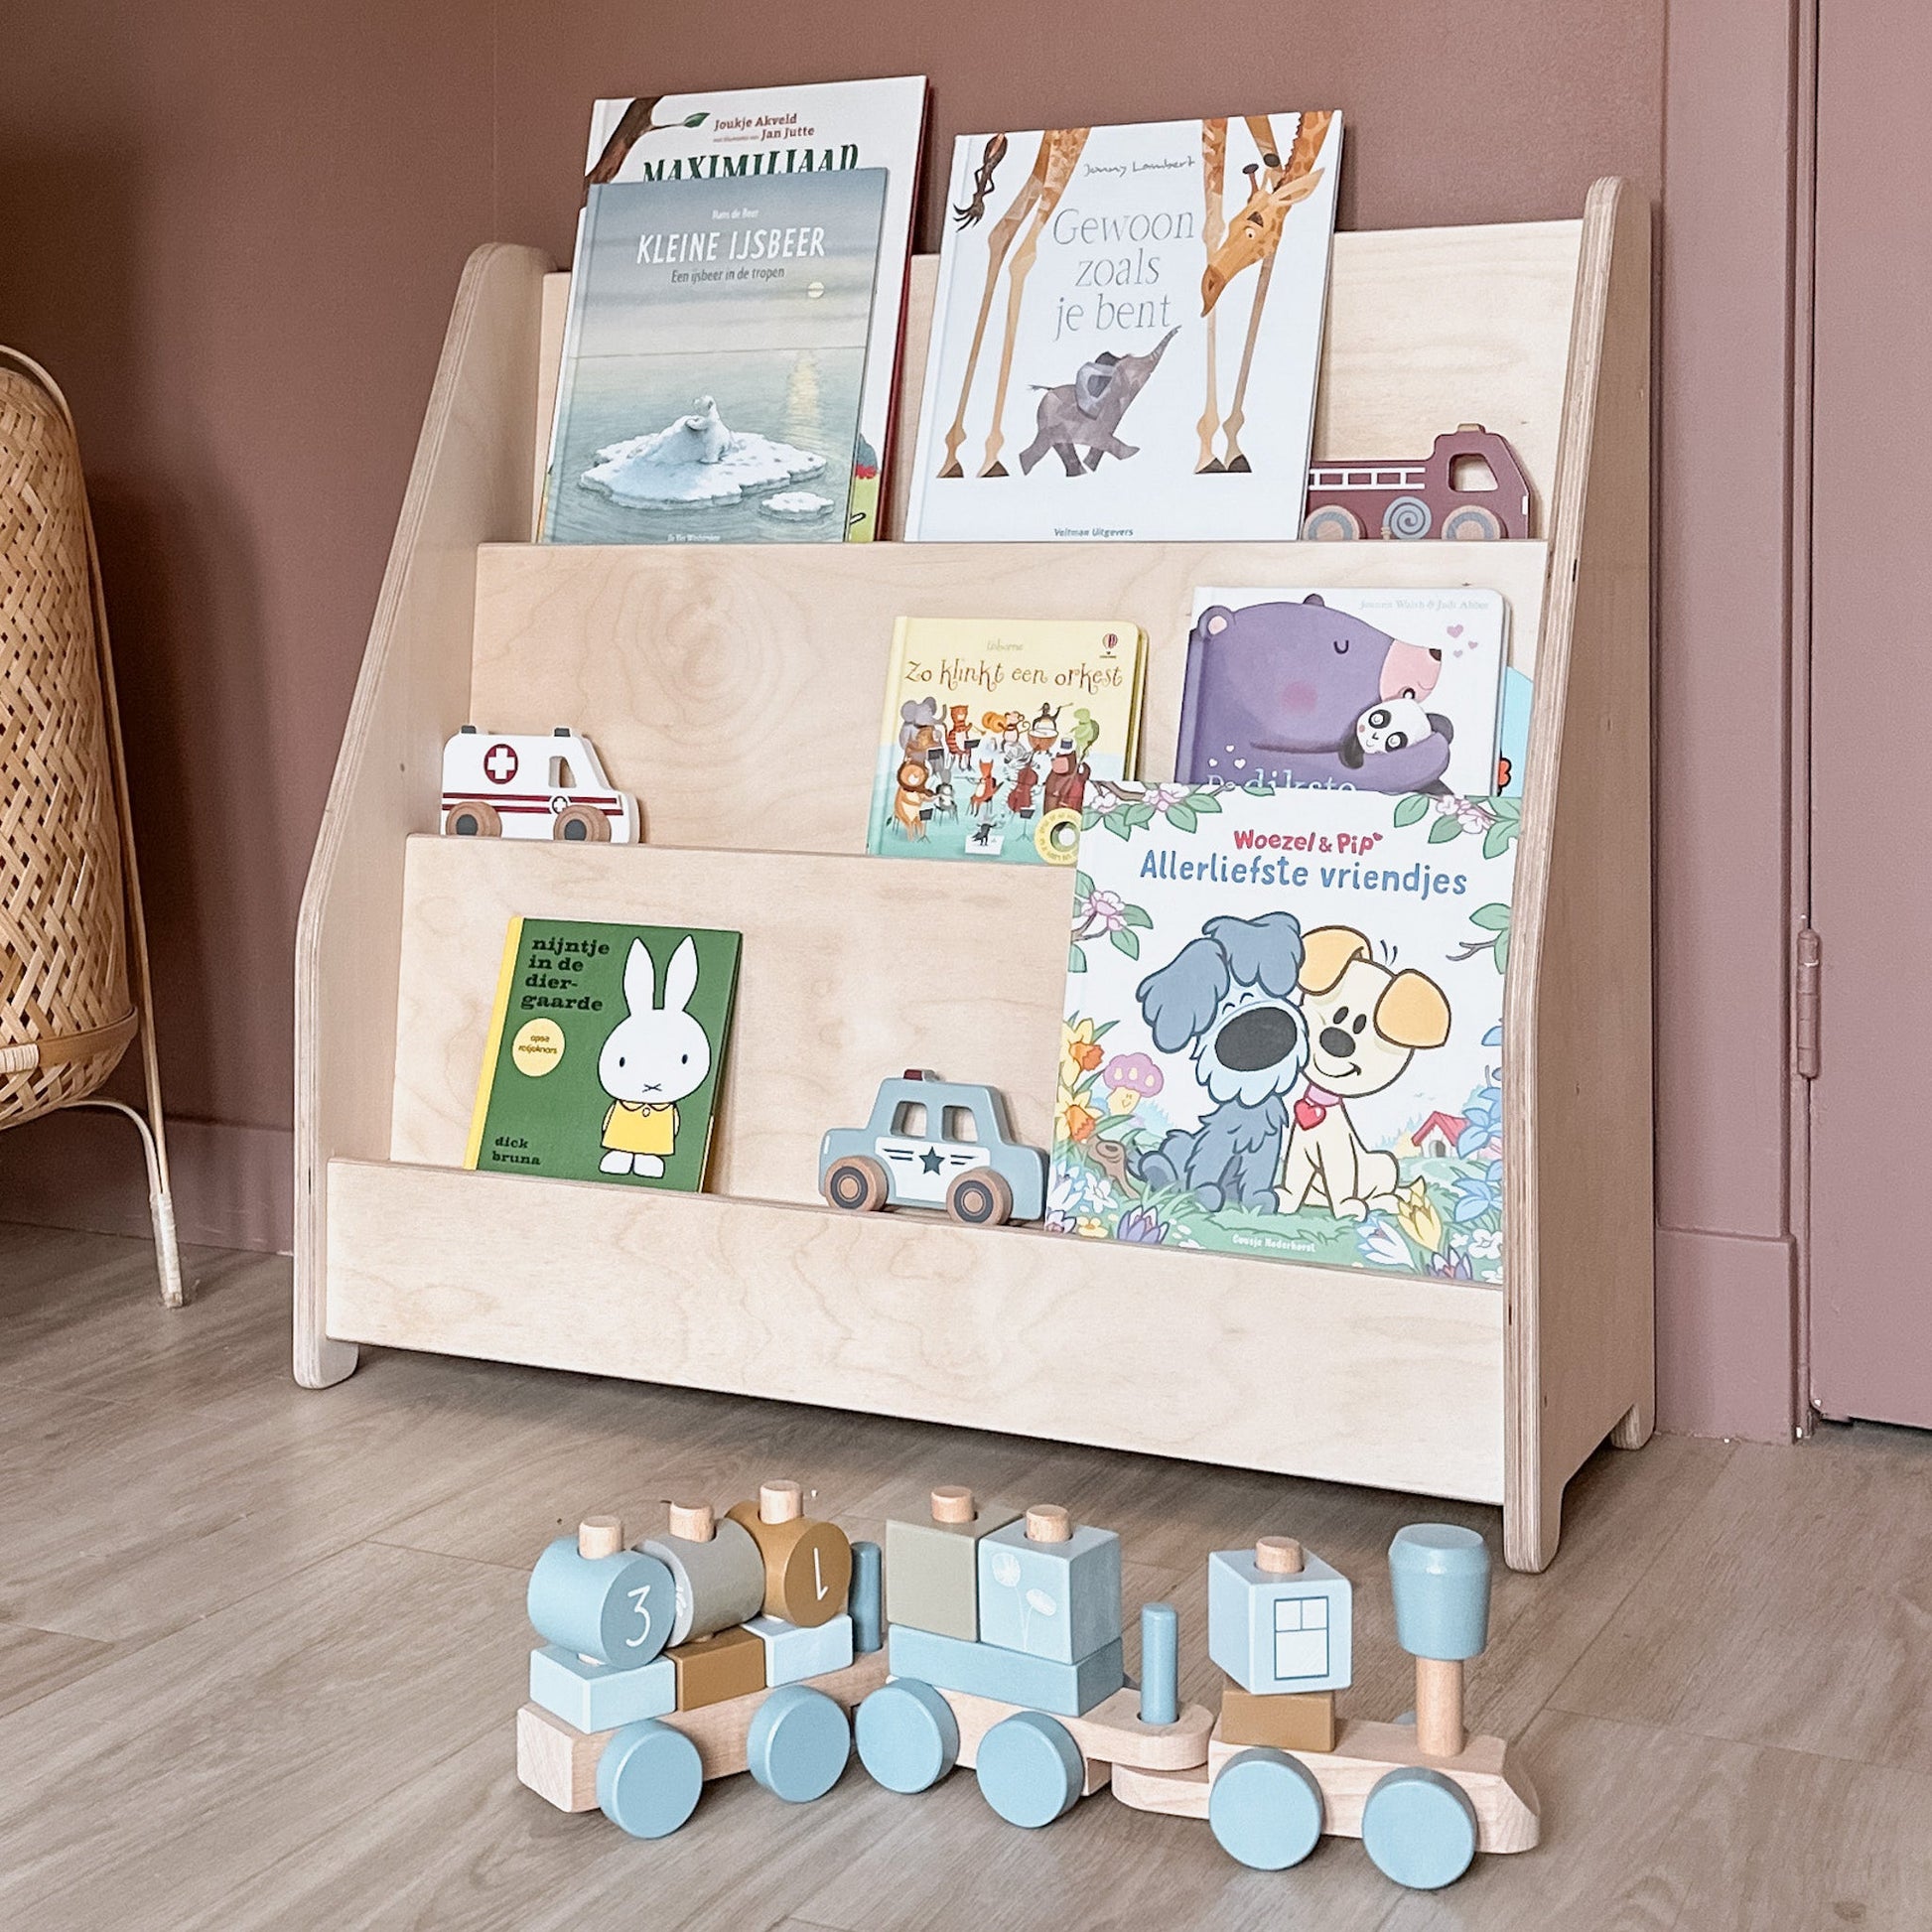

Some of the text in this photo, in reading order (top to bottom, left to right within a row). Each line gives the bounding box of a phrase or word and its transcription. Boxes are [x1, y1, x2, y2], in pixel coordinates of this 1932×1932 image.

[713, 112, 797, 131] Joukje Akveld
[760, 128, 781, 142] Jan
[783, 126, 815, 140] Jutte
[1133, 155, 1195, 173] Lambert
[1052, 207, 1194, 245] Gewoon
[636, 226, 825, 264] KLEINE IJSBEER
[671, 266, 785, 284] Een ijsbeer in de tropen
[1074, 248, 1161, 287] zoals
[1052, 293, 1172, 342] je bent
[1092, 527, 1134, 538] Uitgevers
[904, 658, 1123, 695] Zo klinkt een orkest
[1233, 829, 1374, 856] Woezel & Pip
[1140, 849, 1467, 900] Allerliefste vriendjes
[531, 937, 610, 958] nijntje
[528, 954, 584, 972] in de
[524, 973, 578, 990] dier-
[520, 994, 603, 1011] gaarde
[494, 1137, 528, 1149] dick
[491, 1152, 540, 1166] bruna
[625, 1585, 651, 1648] 3
